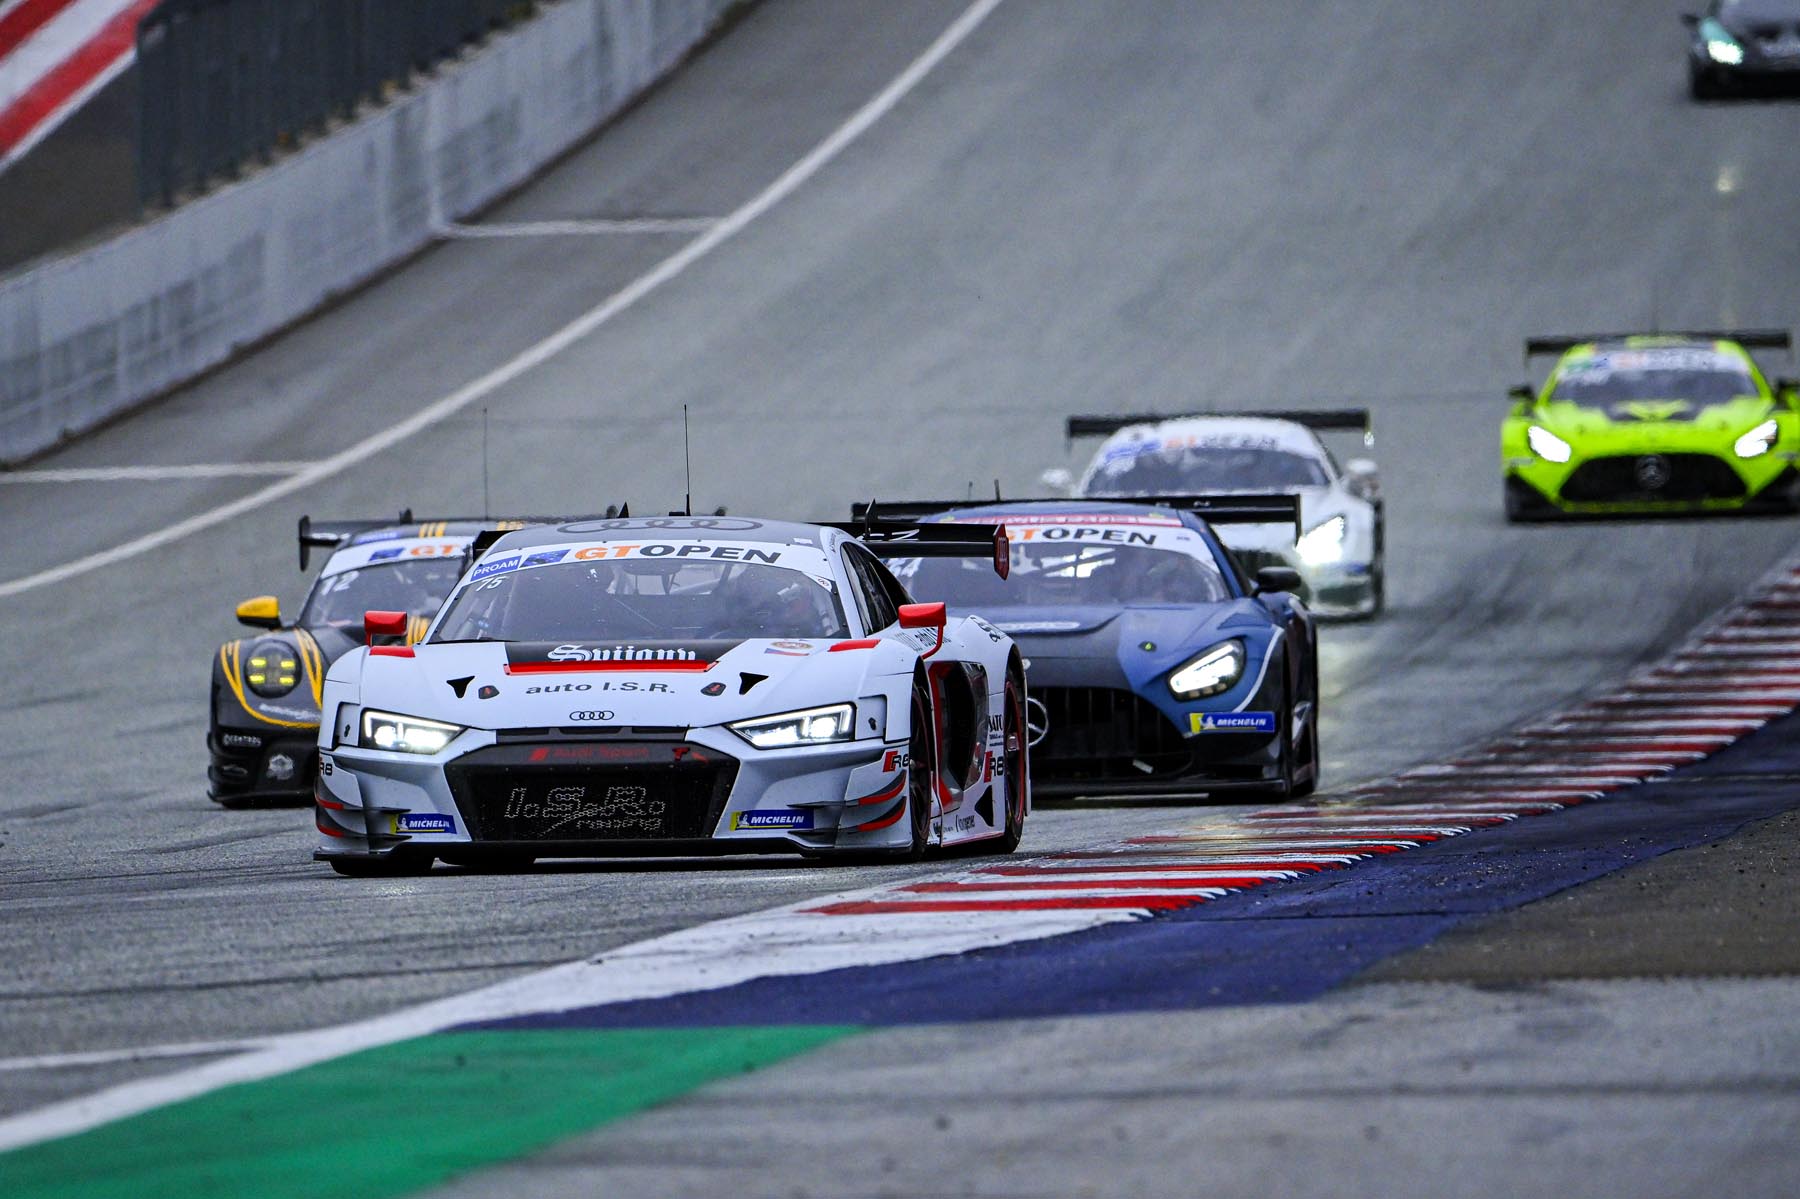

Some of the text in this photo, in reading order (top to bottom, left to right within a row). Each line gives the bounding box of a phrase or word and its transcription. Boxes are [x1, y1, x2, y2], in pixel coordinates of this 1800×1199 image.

[473, 559, 519, 577] PROAM
[320, 570, 360, 596] 12
[475, 575, 509, 592] 75
[525, 682, 676, 694] auto I.S.R.
[1216, 718, 1267, 726] MICHELIN
[751, 815, 805, 825] MICHELIN
